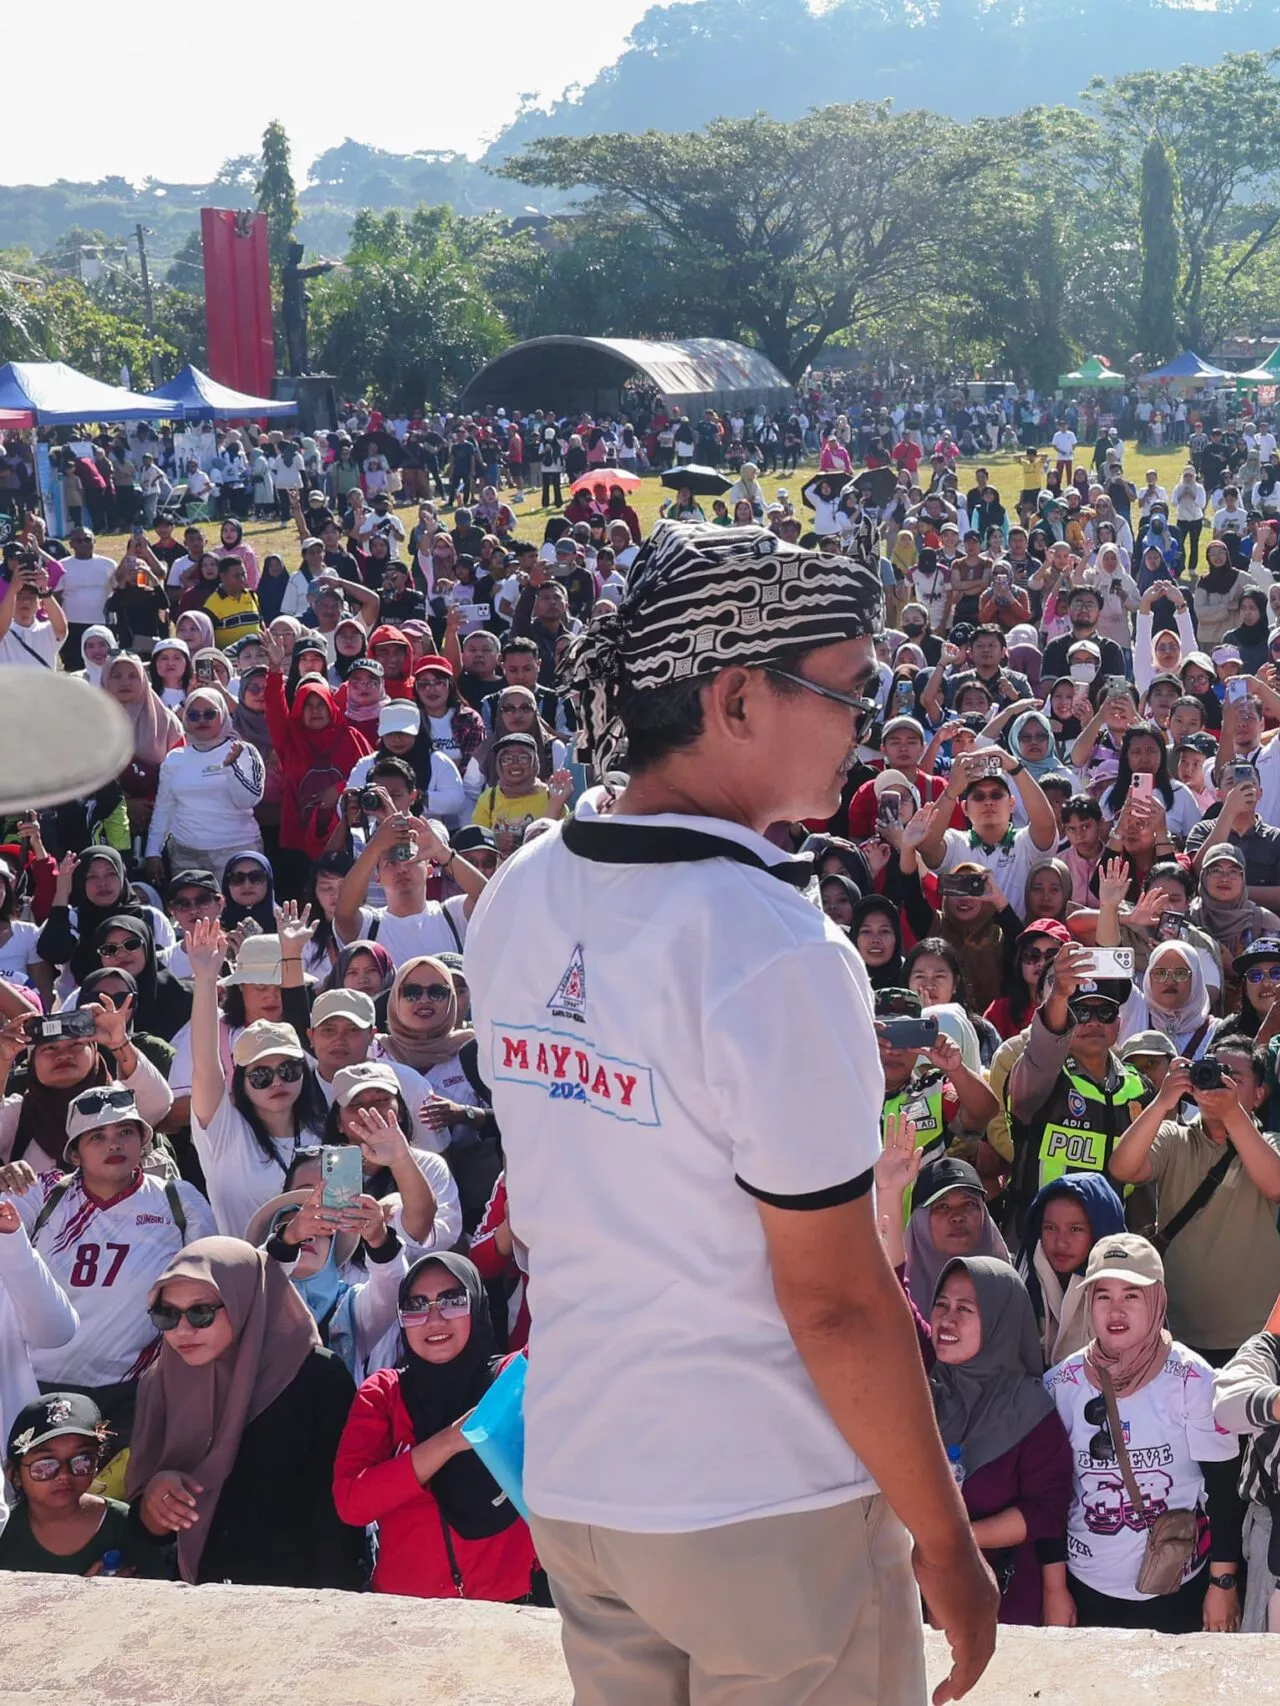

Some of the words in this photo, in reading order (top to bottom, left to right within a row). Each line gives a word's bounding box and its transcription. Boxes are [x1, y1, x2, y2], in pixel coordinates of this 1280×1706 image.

[502, 1036, 637, 1107] MAYDAY
[549, 1081, 587, 1102] 202
[921, 1120, 934, 1129] AD
[1062, 1118, 1082, 1128] ADI
[1083, 1121, 1091, 1129] G
[1047, 1131, 1097, 1164] POL
[70, 1242, 130, 1287] 87
